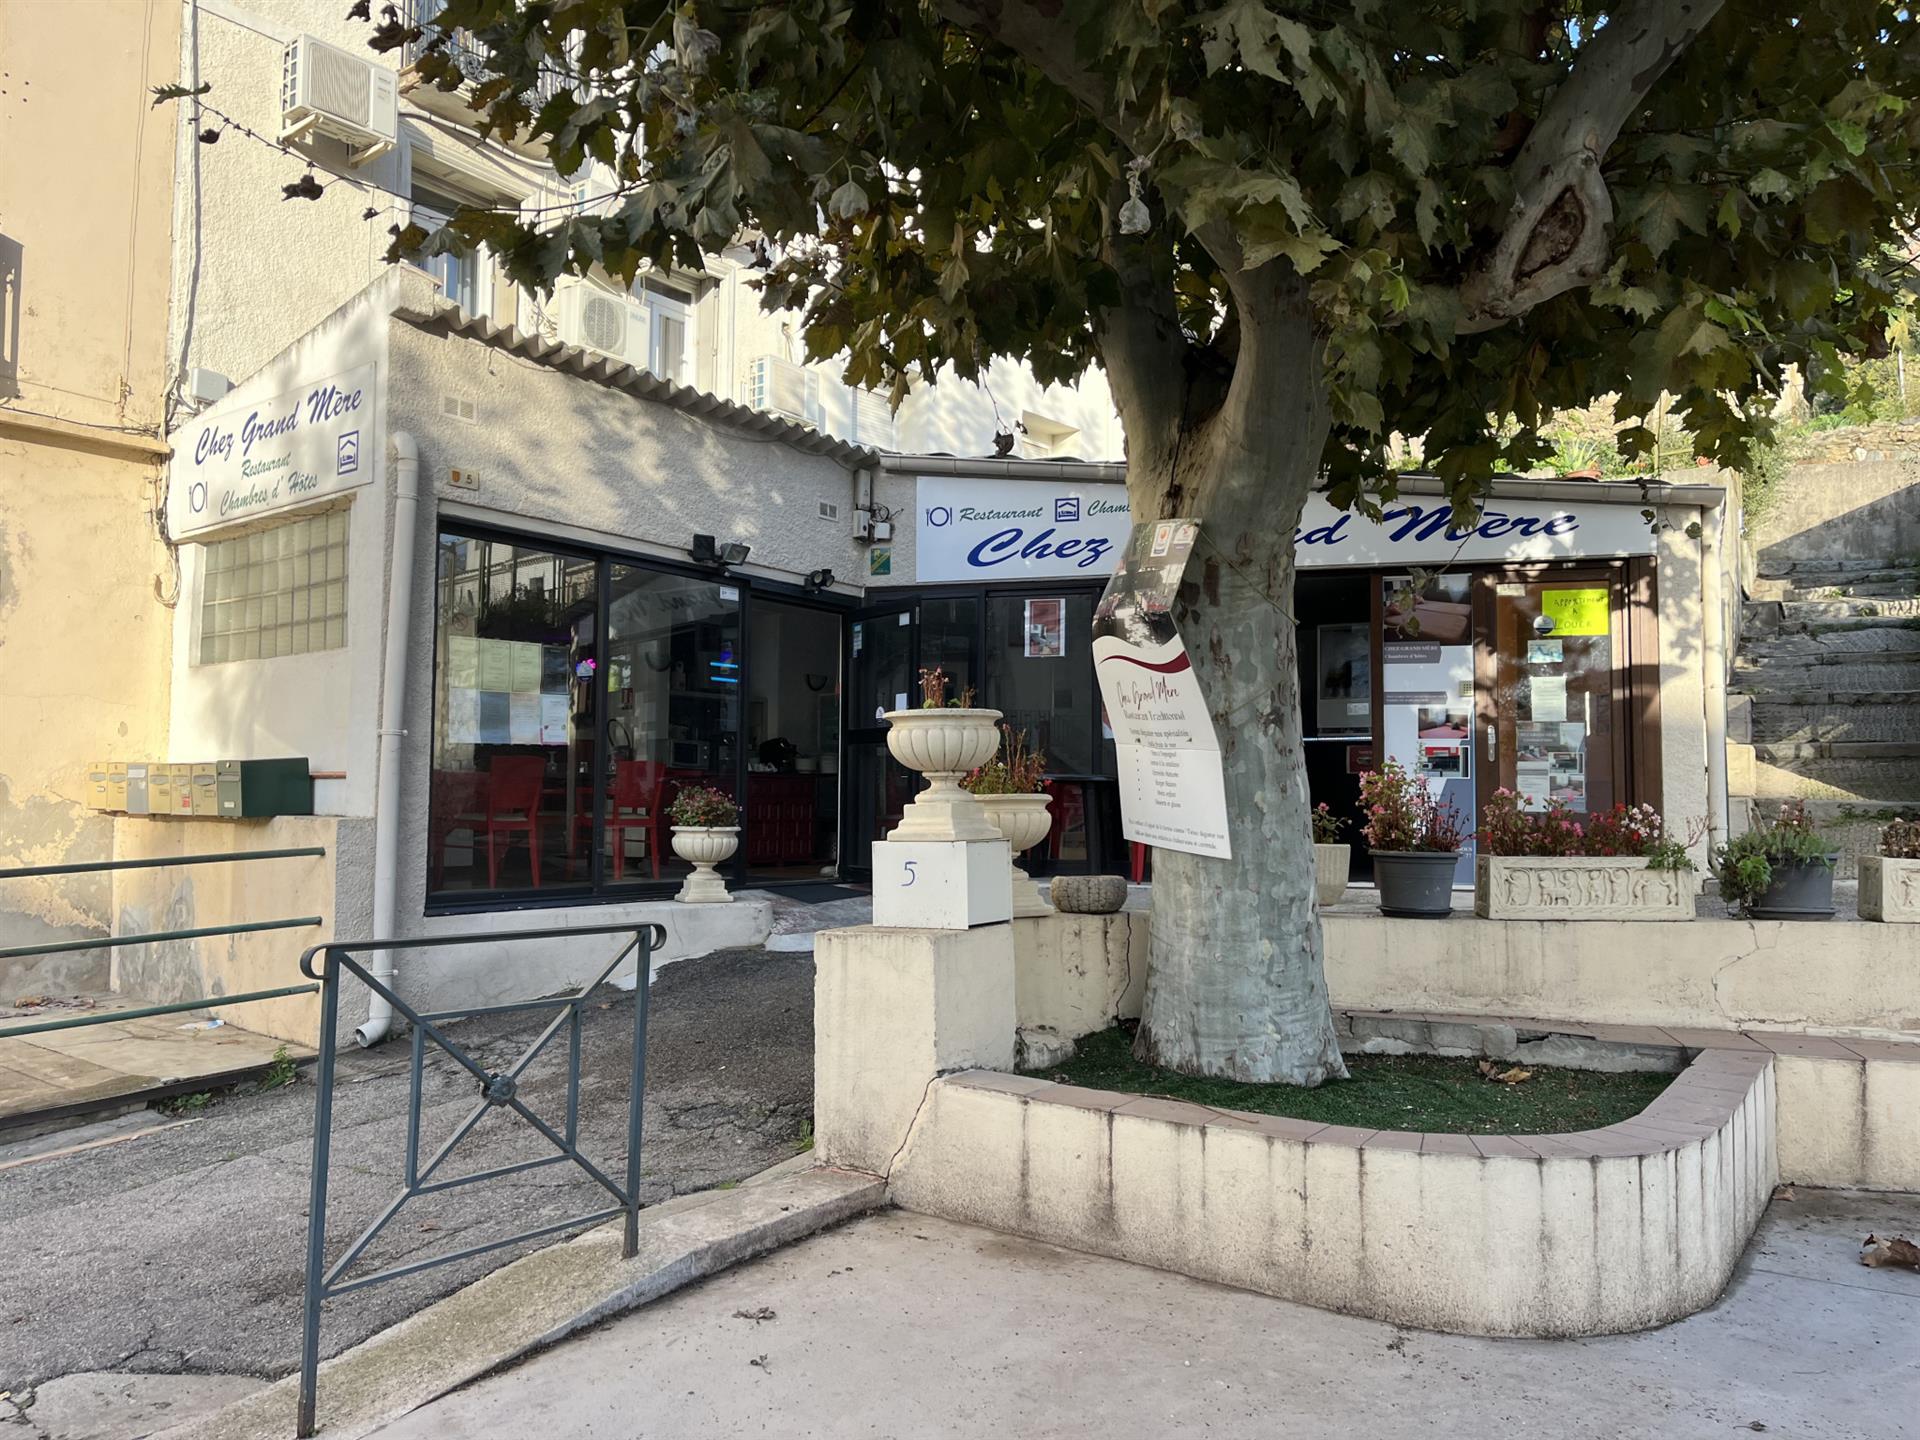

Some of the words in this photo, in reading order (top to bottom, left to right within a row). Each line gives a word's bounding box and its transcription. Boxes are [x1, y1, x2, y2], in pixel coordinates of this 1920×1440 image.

[194, 426, 234, 466] Chez
[241, 401, 300, 456] Grand
[307, 385, 362, 424] Mère
[241, 452, 291, 480] Restaurant
[466, 473, 473, 485] 5
[219, 483, 268, 517] Chambres
[288, 470, 318, 496] Hôtes
[959, 506, 1043, 522] Restaurant
[1087, 499, 1131, 517] Cham
[967, 528, 1113, 567] Chez
[1382, 505, 1580, 542] Mère
[901, 861, 918, 887] 5
